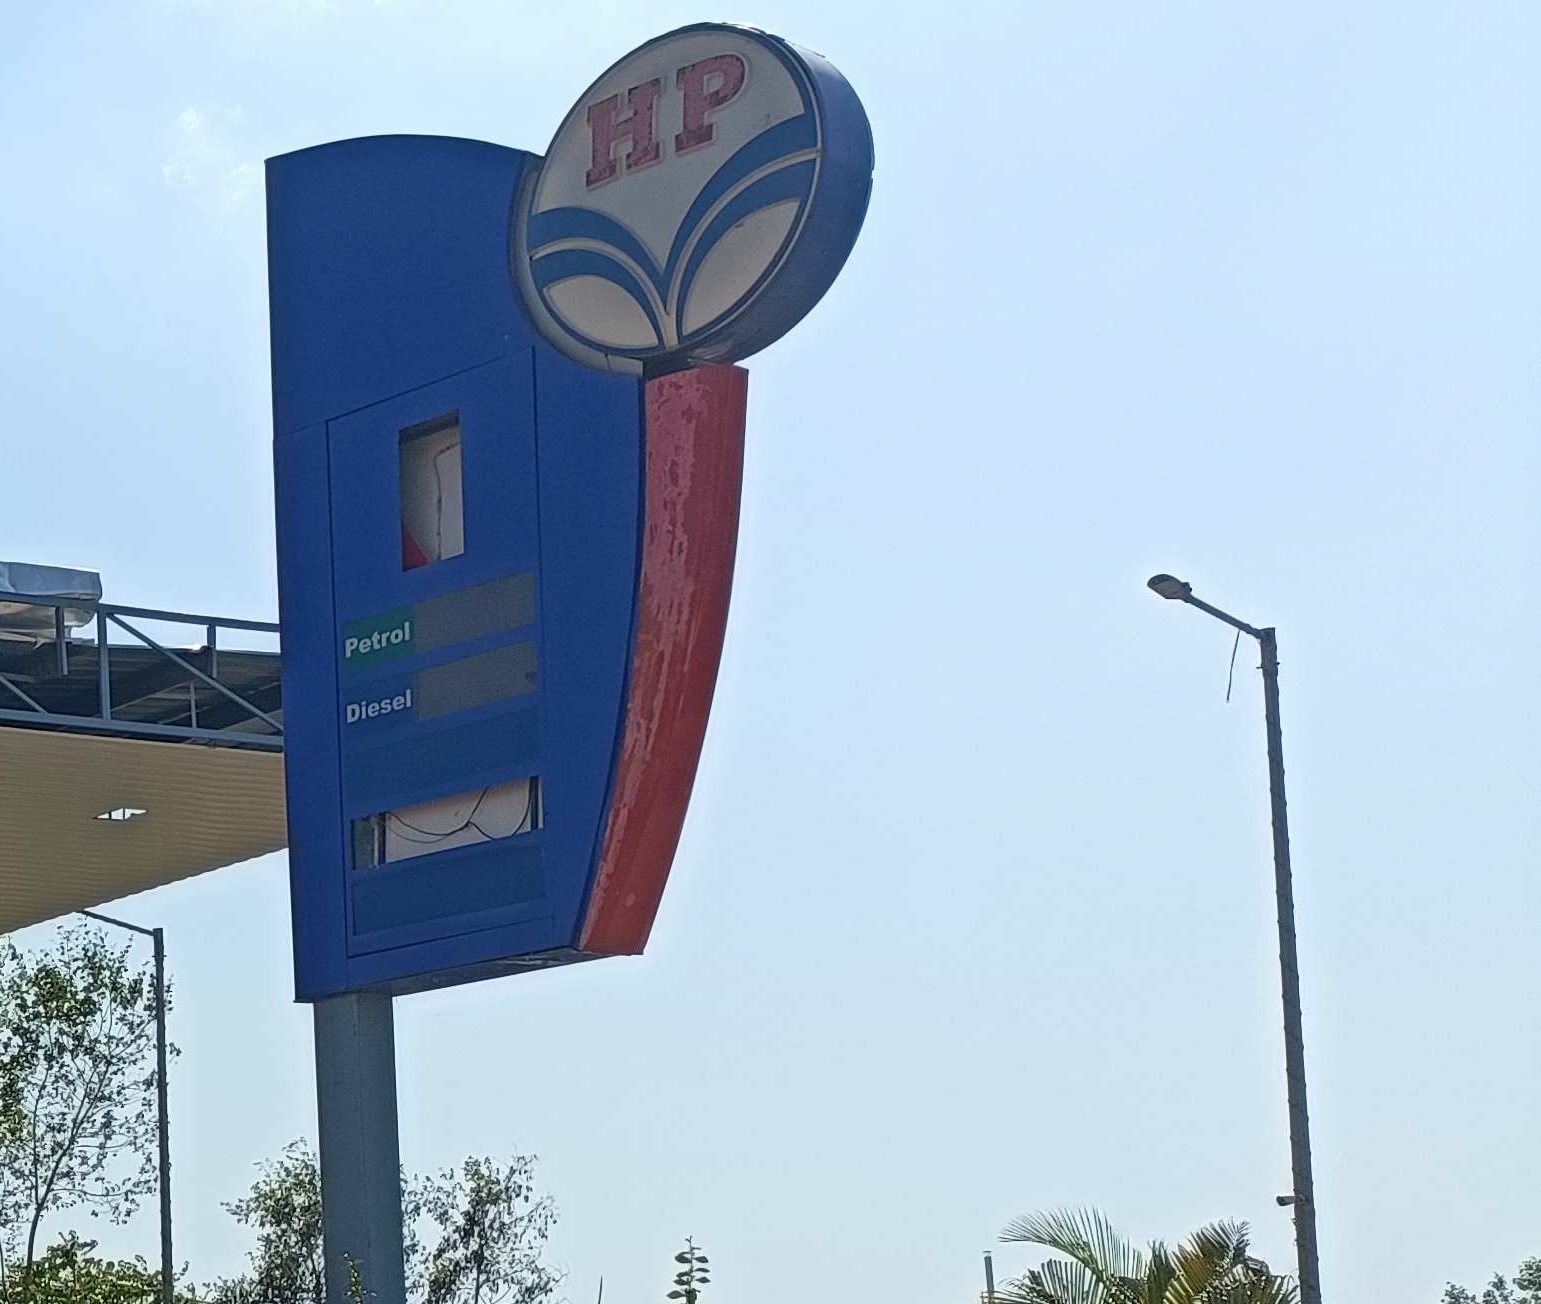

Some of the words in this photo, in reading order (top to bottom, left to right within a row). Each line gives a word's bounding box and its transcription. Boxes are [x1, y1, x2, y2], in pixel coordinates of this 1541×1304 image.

[585, 53, 747, 190] HP
[344, 620, 411, 659] Petrol
[345, 688, 413, 724] Diesel
